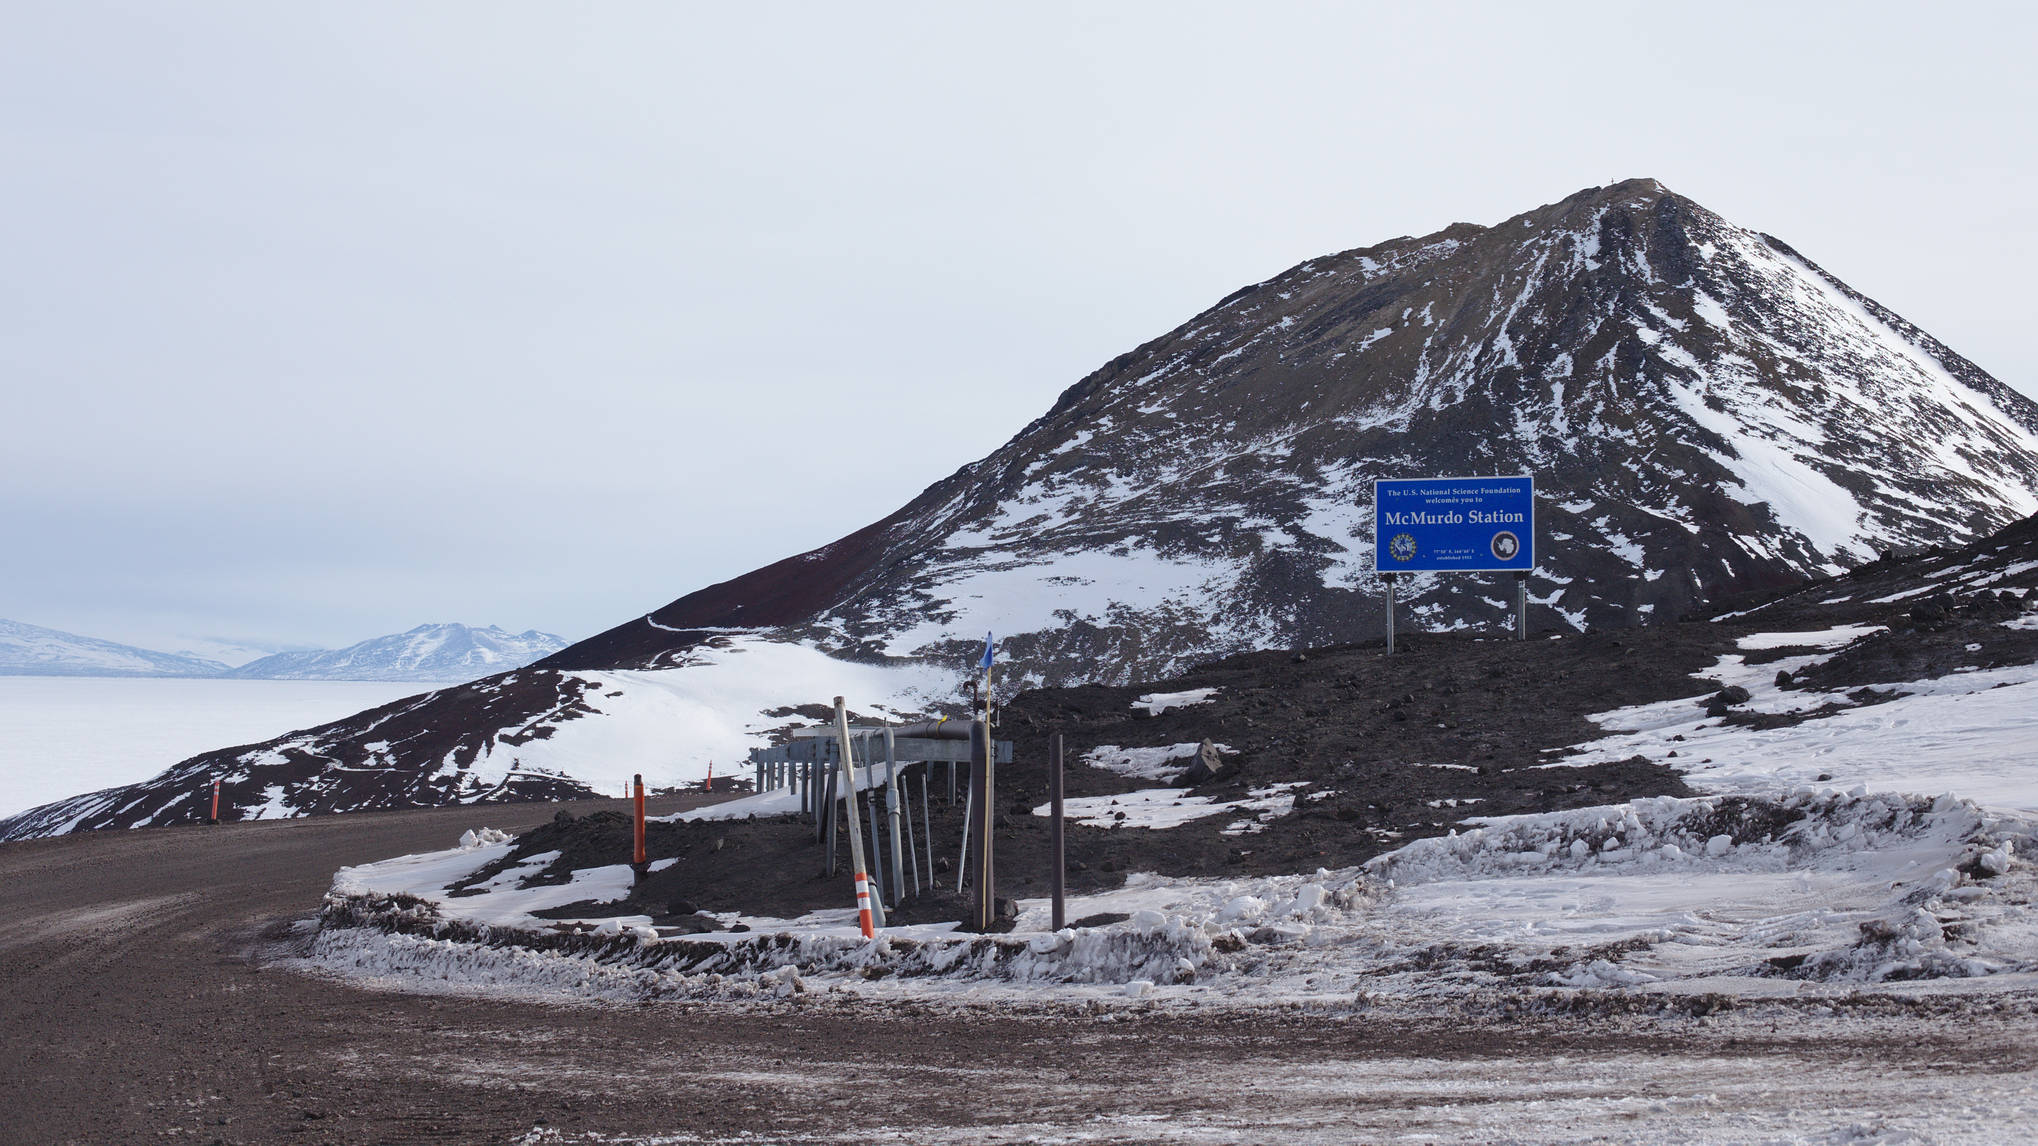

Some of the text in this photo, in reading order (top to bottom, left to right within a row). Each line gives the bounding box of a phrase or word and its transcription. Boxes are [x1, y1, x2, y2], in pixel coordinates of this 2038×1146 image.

[1420, 488, 1450, 496] National
[1385, 509, 1524, 525] McMurdo Station
